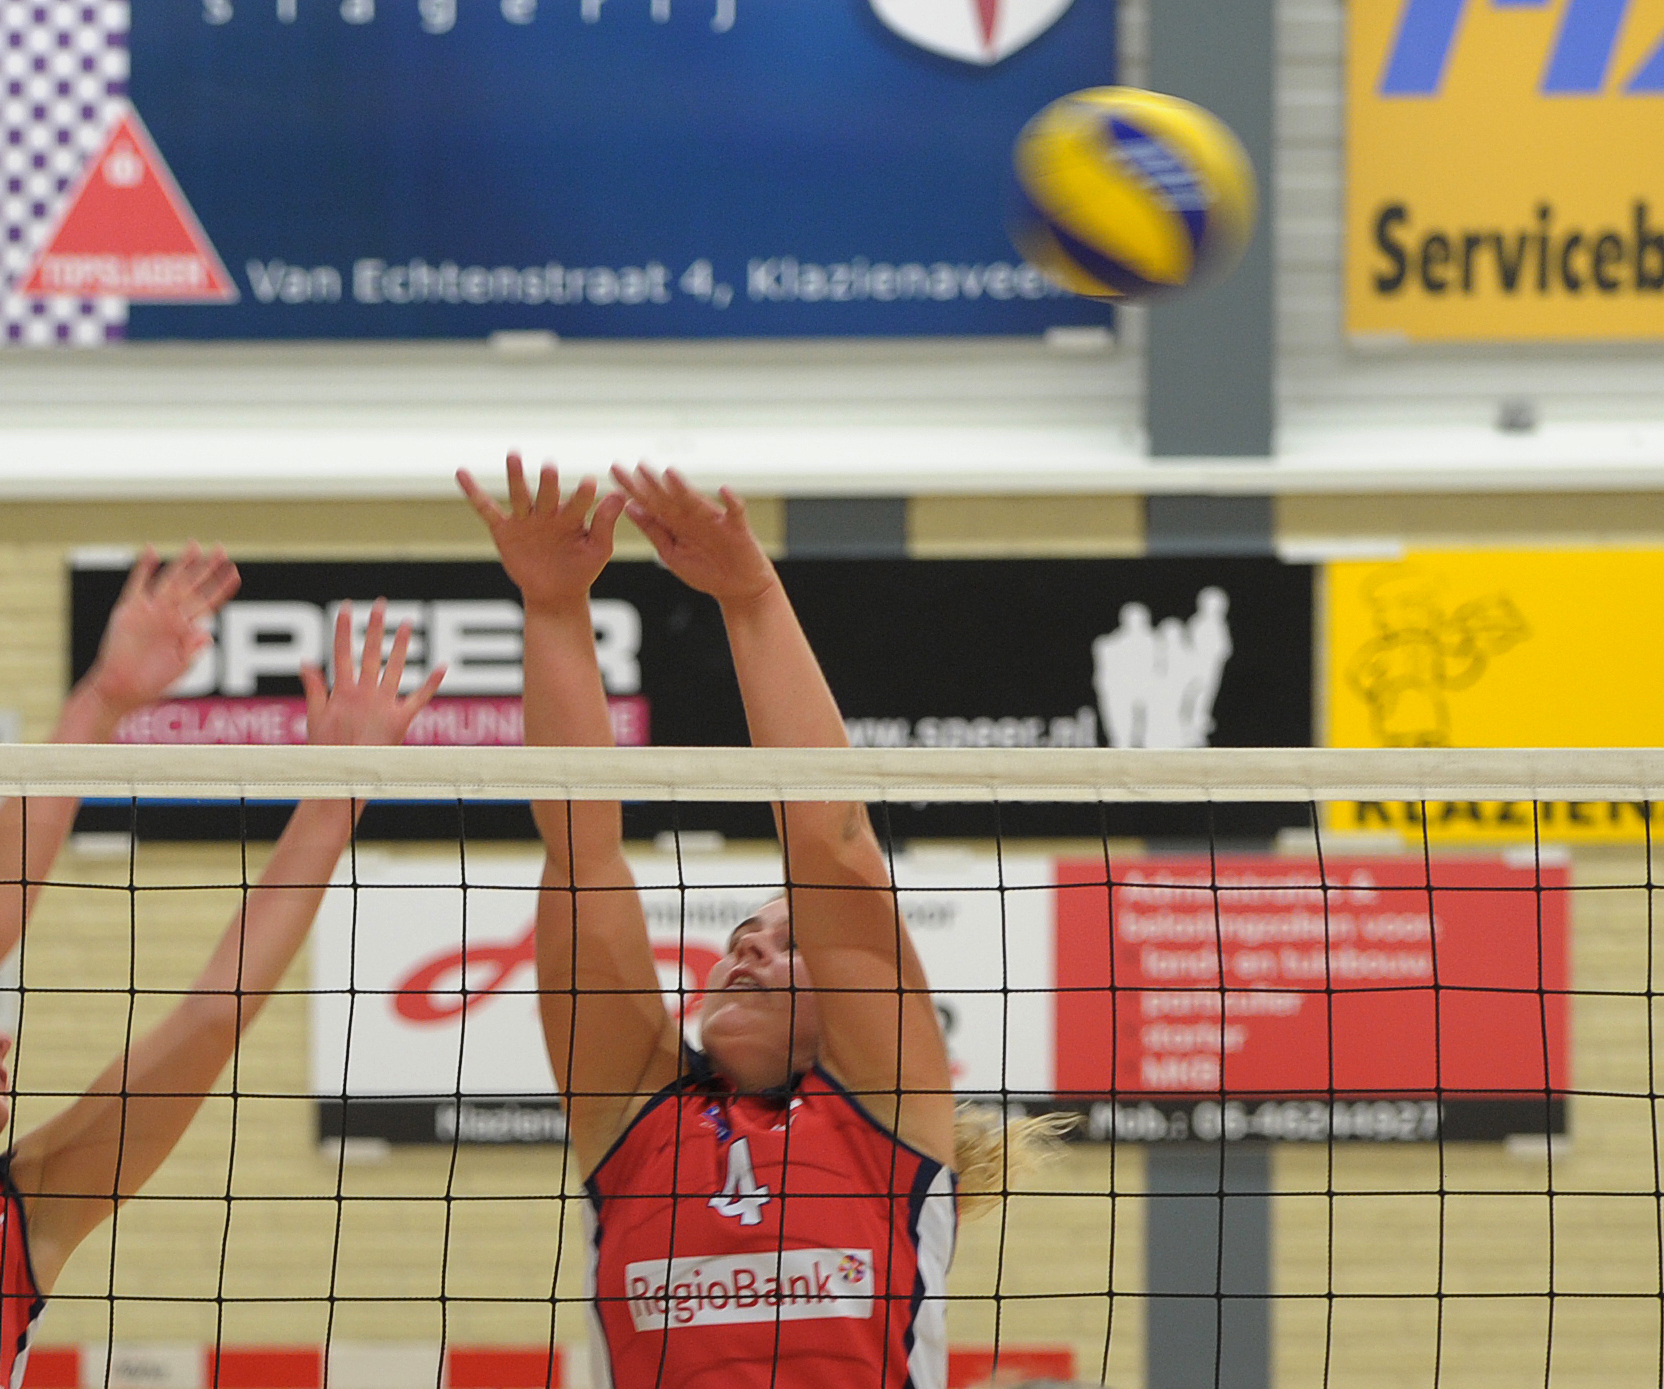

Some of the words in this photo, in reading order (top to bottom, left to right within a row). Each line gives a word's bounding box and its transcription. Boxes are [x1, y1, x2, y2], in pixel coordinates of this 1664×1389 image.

[245, 259, 341, 303] Van
[353, 259, 670, 304] Echtenstraat
[682, 257, 732, 310] 4,
[747, 257, 1071, 302] Klazienavee
[1373, 203, 1664, 295] Serviceb
[707, 1136, 770, 1225] 4
[630, 1262, 837, 1323] RegioBank
